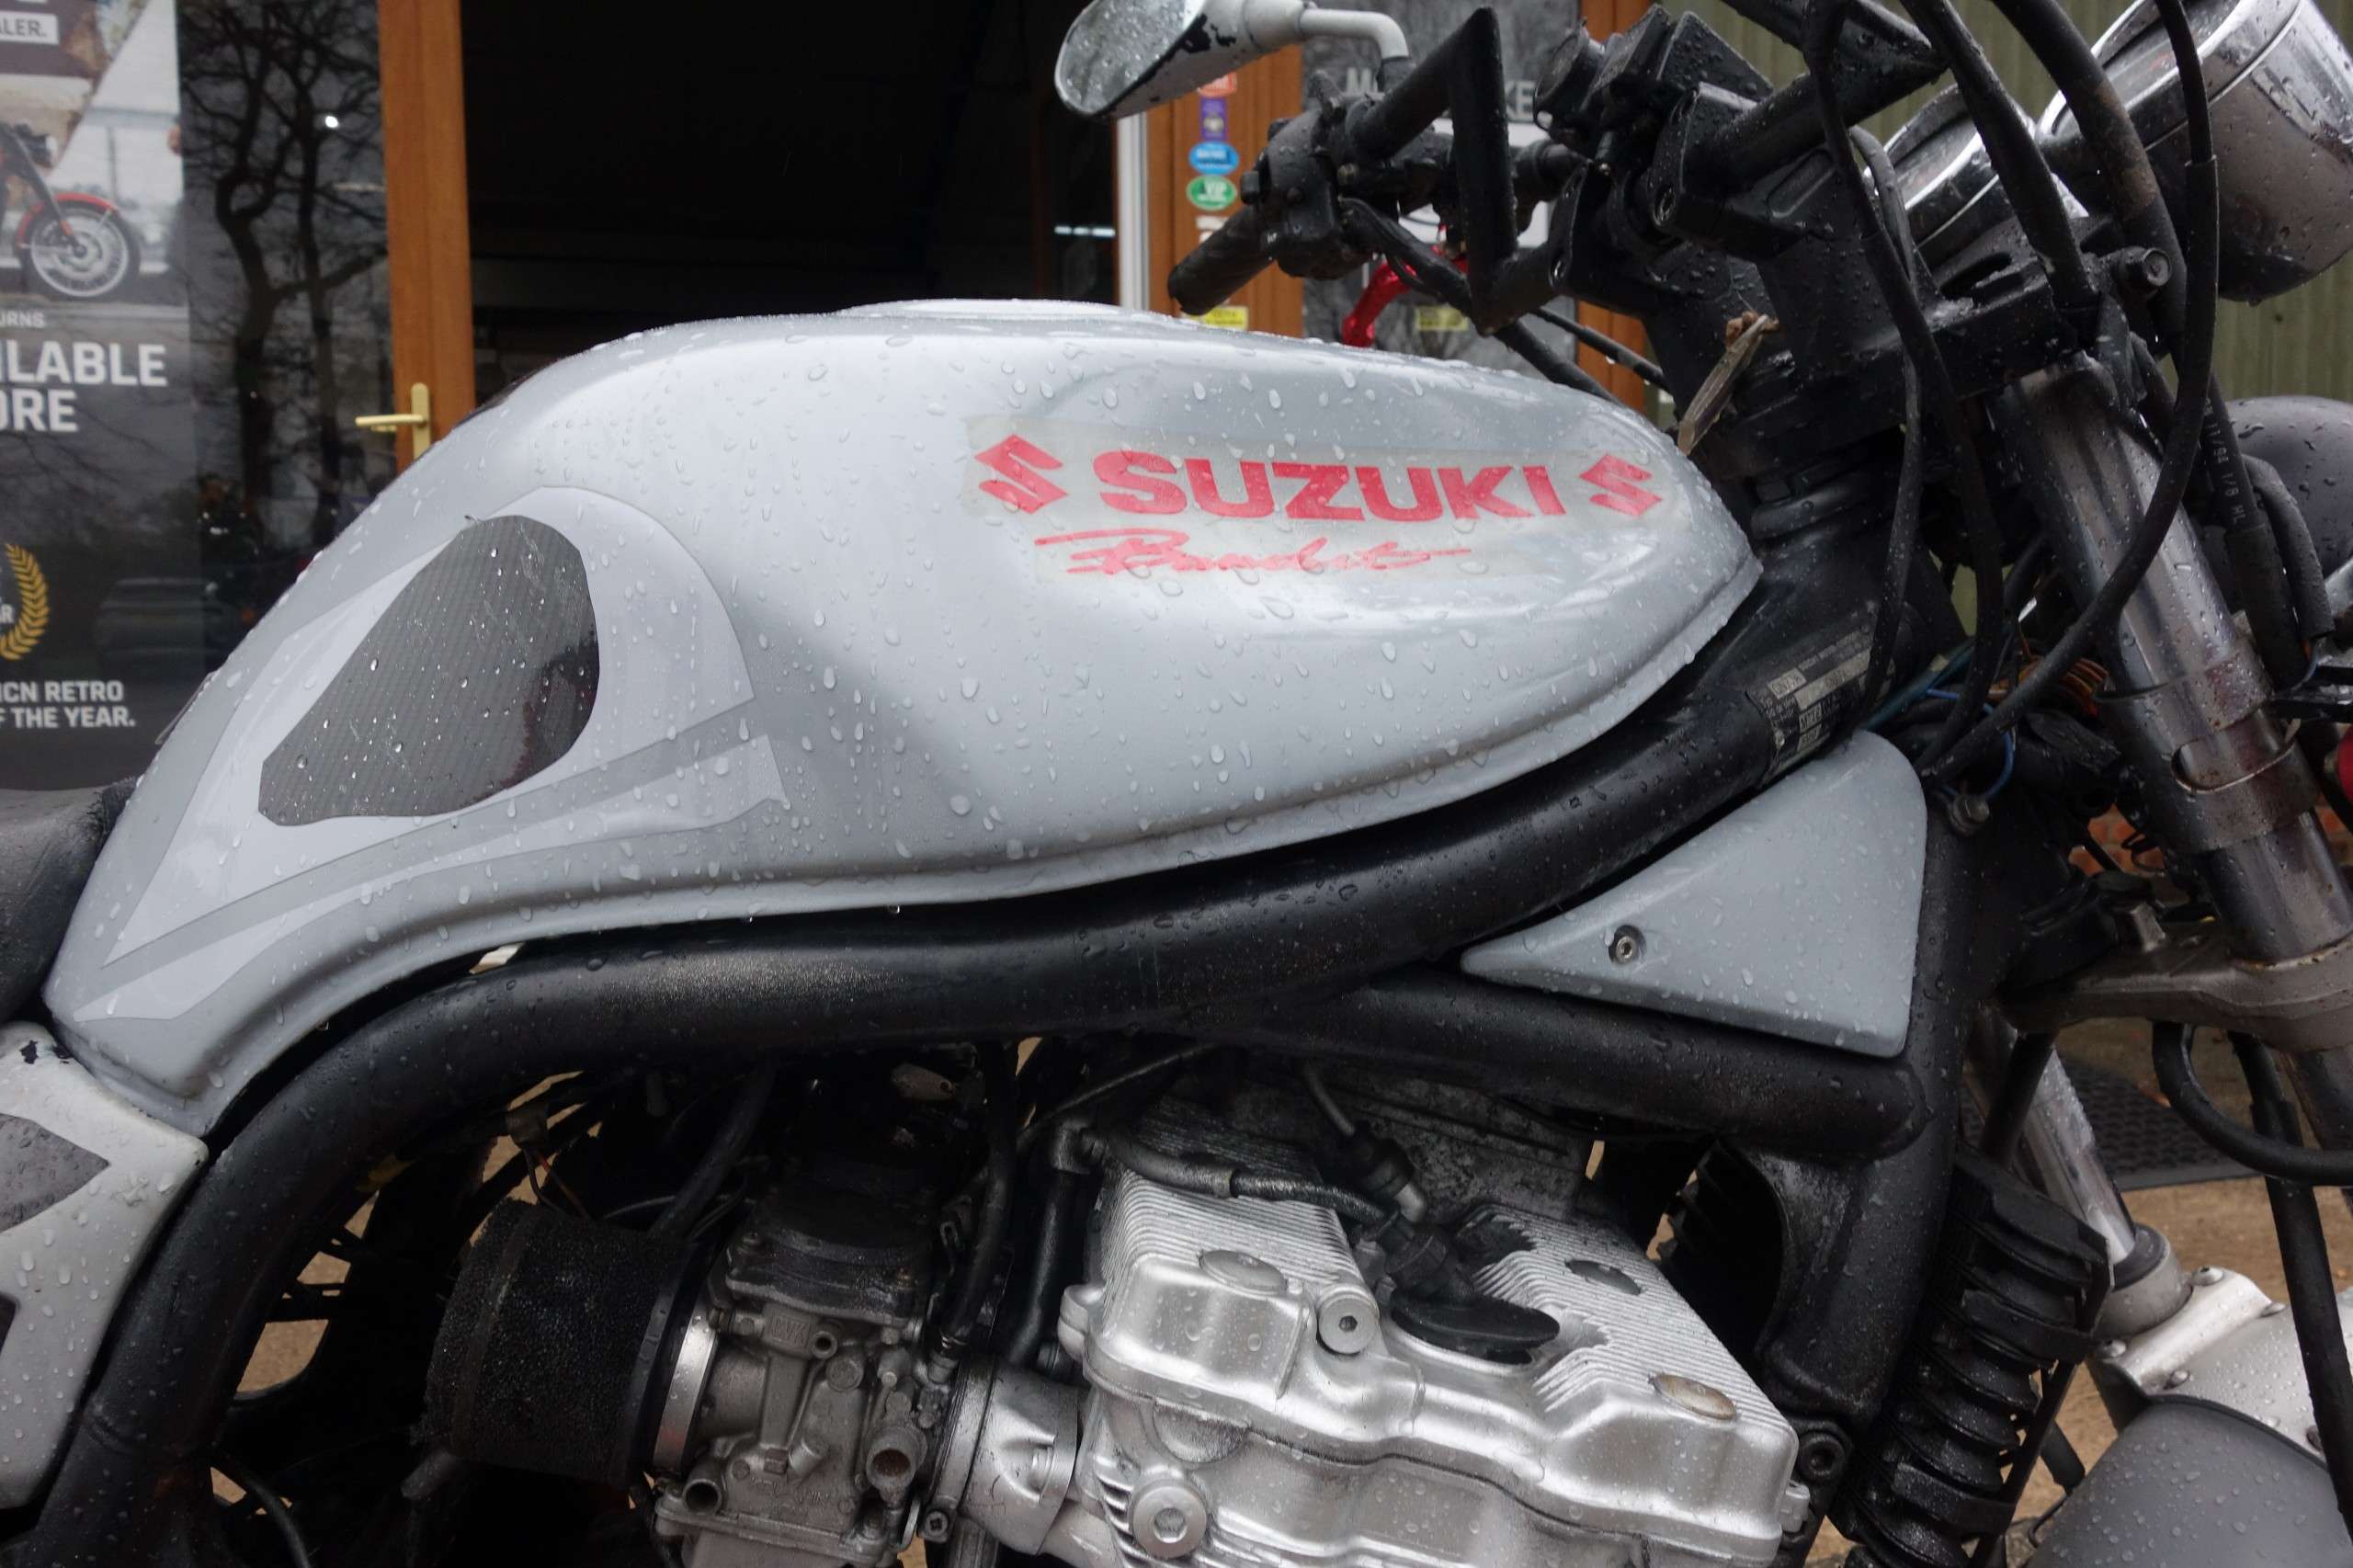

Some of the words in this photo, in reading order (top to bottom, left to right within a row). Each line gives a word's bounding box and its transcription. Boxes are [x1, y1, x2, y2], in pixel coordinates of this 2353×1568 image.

[0, 17, 47, 37] LER.
[1092, 450, 1567, 522] SUZUKI
[44, 680, 124, 702] RETRO
[10, 706, 58, 728] THE
[63, 706, 137, 728] YEAR.
